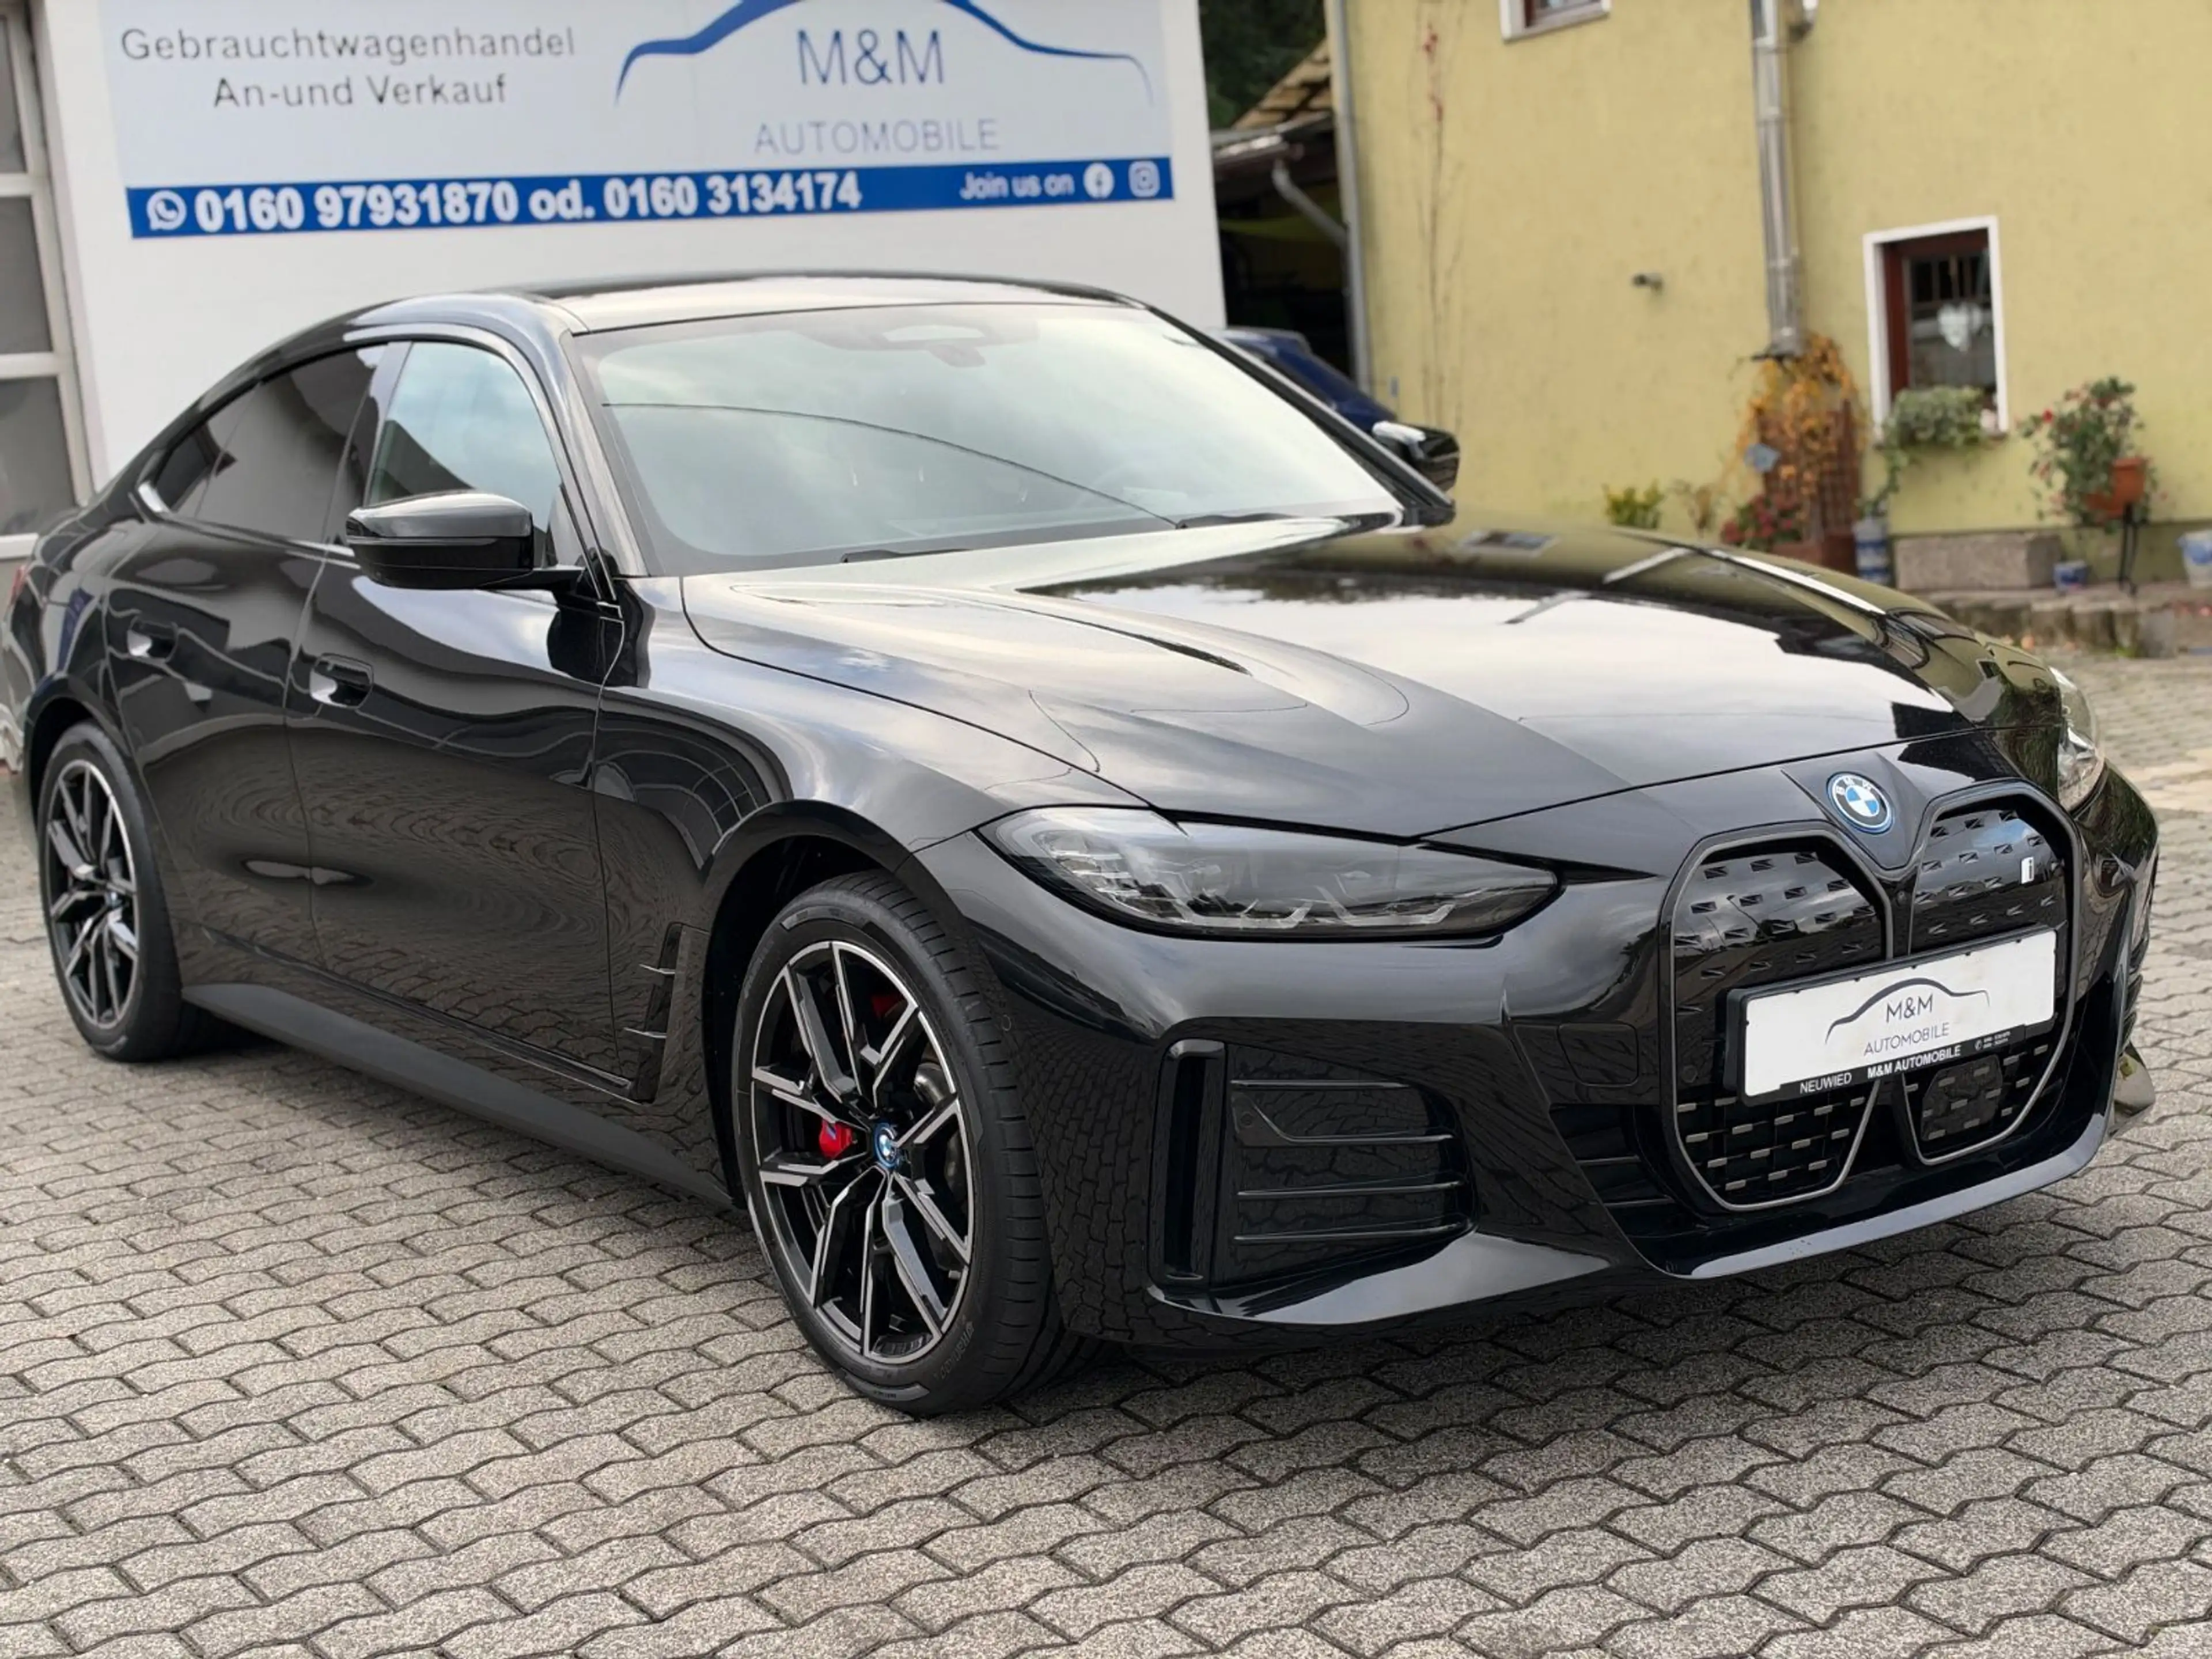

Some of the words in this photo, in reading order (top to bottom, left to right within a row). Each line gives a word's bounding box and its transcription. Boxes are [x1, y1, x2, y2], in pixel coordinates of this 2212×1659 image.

[120, 26, 576, 65] Gebrauchtwagenhandel
[796, 29, 945, 86] M&M
[213, 76, 354, 108] An-und
[366, 74, 508, 106] Verkauf
[754, 118, 1001, 156] AUTOMOBILE
[194, 184, 305, 234] 0160
[313, 180, 520, 229] 97931870
[528, 179, 596, 222] od.
[602, 175, 699, 219] 0160
[706, 171, 863, 214] 3134174
[959, 172, 1008, 202] Join
[1010, 176, 1041, 199] us
[1043, 174, 1074, 196] on
[1885, 994, 1933, 1022] M&M
[1863, 1022, 1950, 1056] AUTOMOBILE
[1800, 1072, 1852, 1094] NEUWIED
[1867, 1063, 1893, 1080] M&M
[1894, 1046, 1961, 1073] AUTOMOBILE
